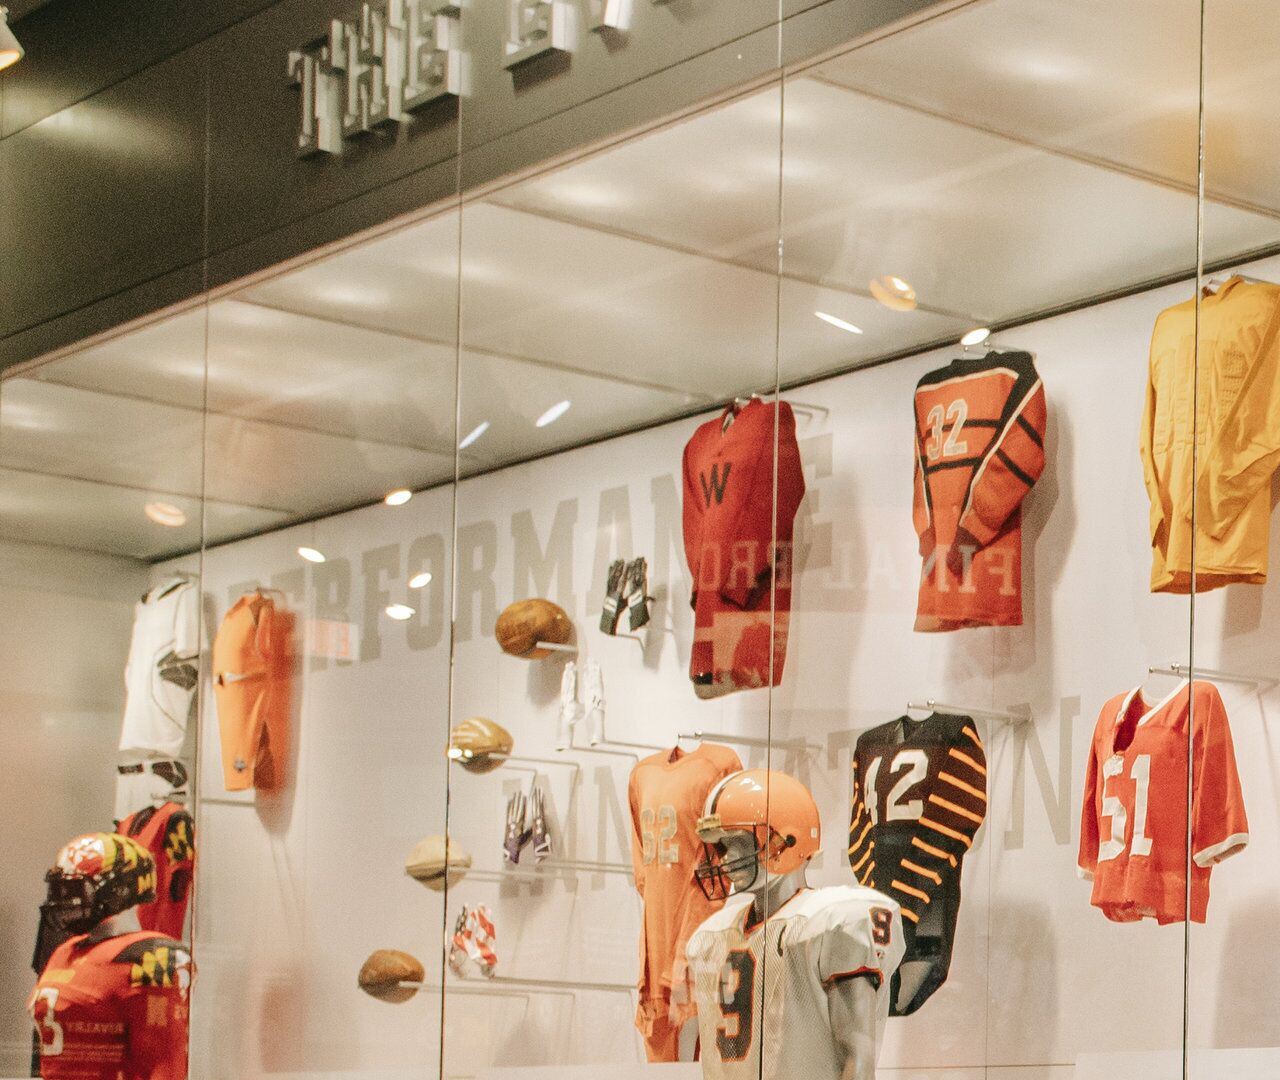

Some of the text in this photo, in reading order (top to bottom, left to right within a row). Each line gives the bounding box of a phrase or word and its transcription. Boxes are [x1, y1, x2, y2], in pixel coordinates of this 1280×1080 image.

[925, 398, 968, 461] 32
[700, 462, 731, 508] W
[1097, 754, 1153, 864] 51
[869, 906, 894, 947] 9
[716, 950, 756, 1063] 9
